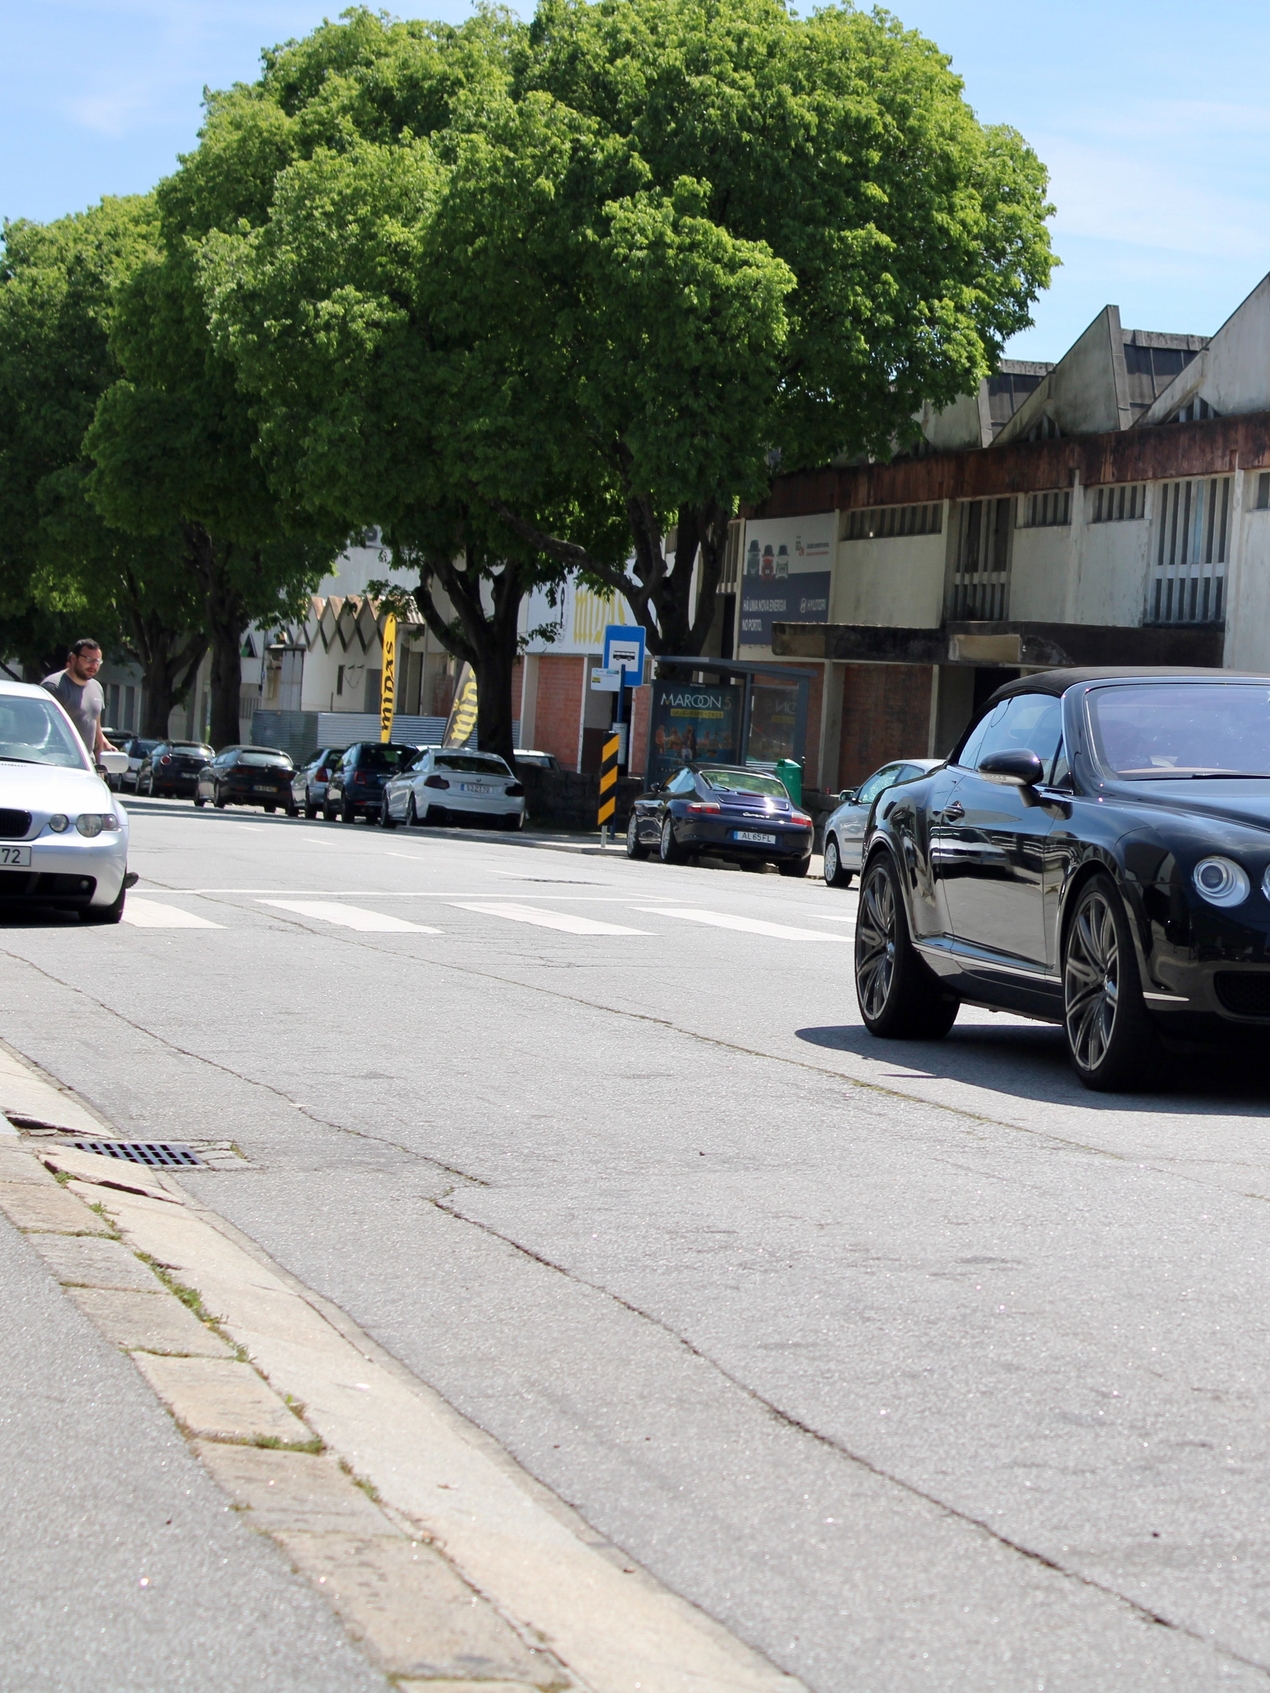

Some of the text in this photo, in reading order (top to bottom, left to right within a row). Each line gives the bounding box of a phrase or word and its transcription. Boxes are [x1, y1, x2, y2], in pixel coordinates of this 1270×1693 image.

[770, 600, 786, 612] ENERGIA
[806, 599, 826, 611] HYUNDAI
[660, 692, 732, 710] MAROON 5
[2, 848, 20, 863] 72
